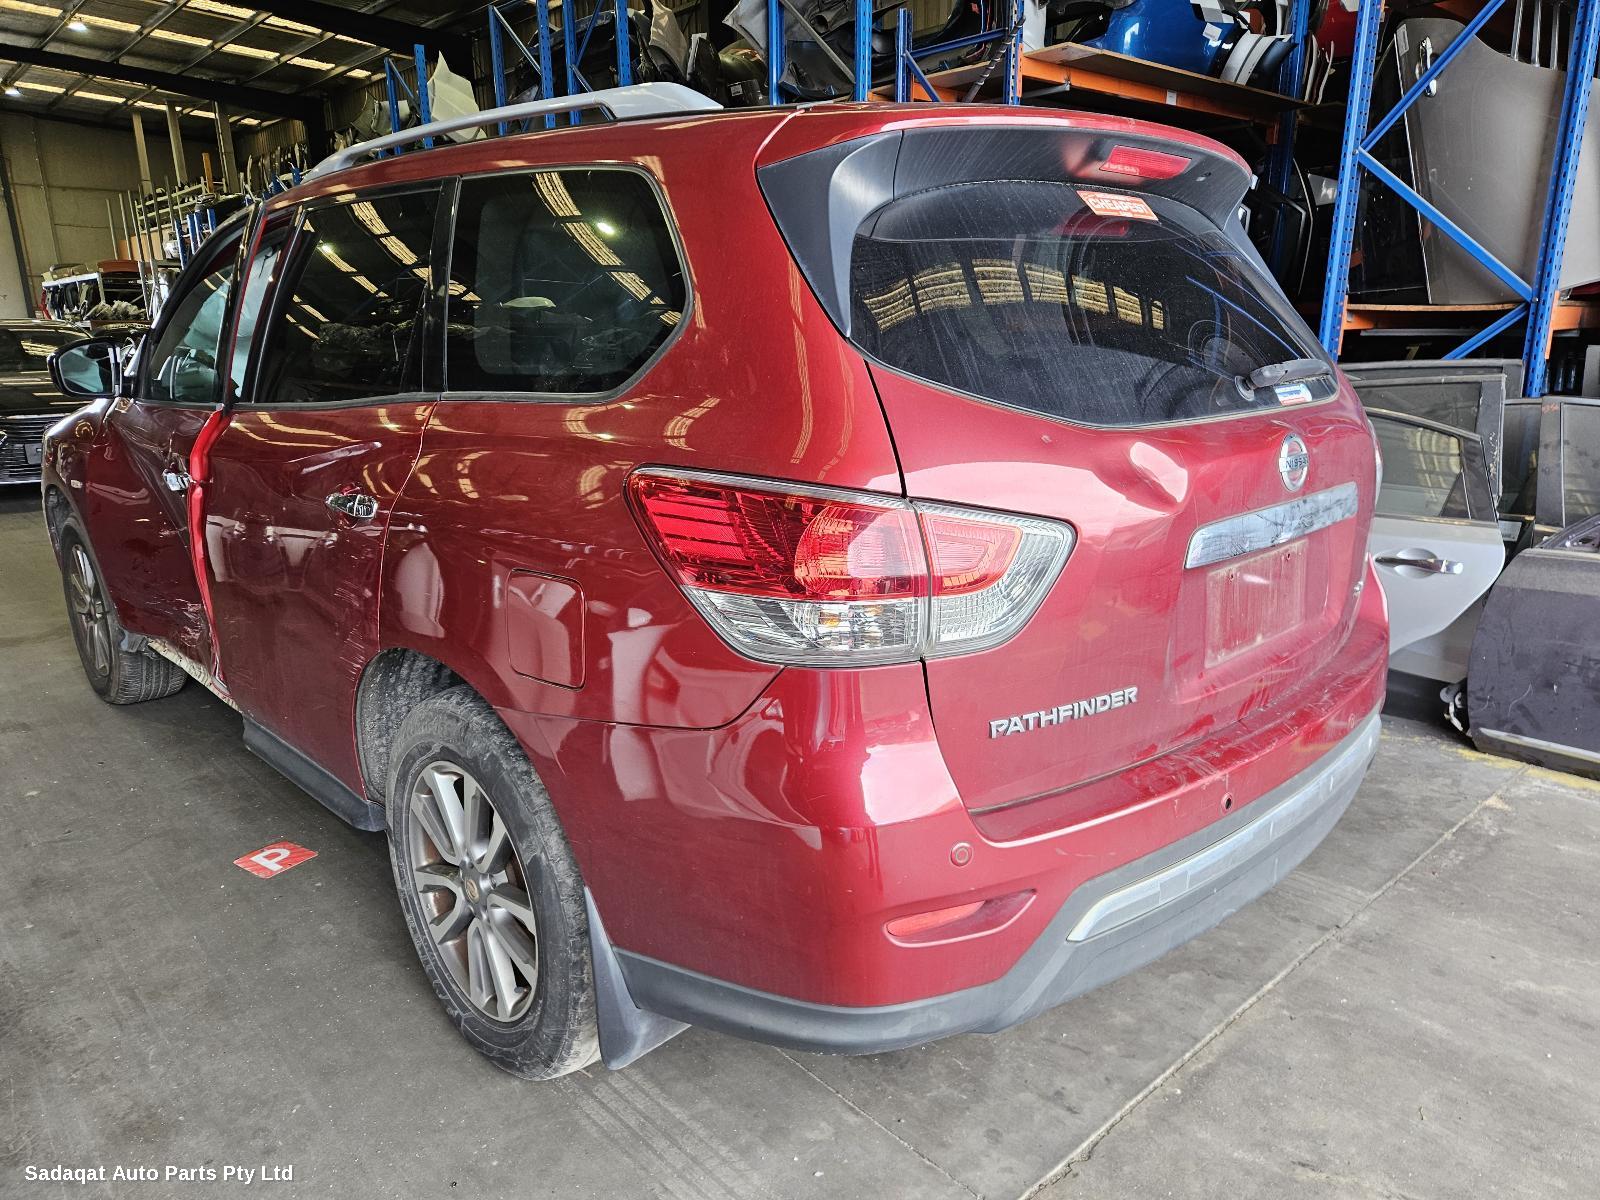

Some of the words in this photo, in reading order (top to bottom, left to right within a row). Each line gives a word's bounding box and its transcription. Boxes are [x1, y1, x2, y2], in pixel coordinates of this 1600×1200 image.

[1086, 197, 1151, 216] CHEAPEST
[989, 686, 1139, 739] PATHFINDER
[250, 848, 290, 872] P
